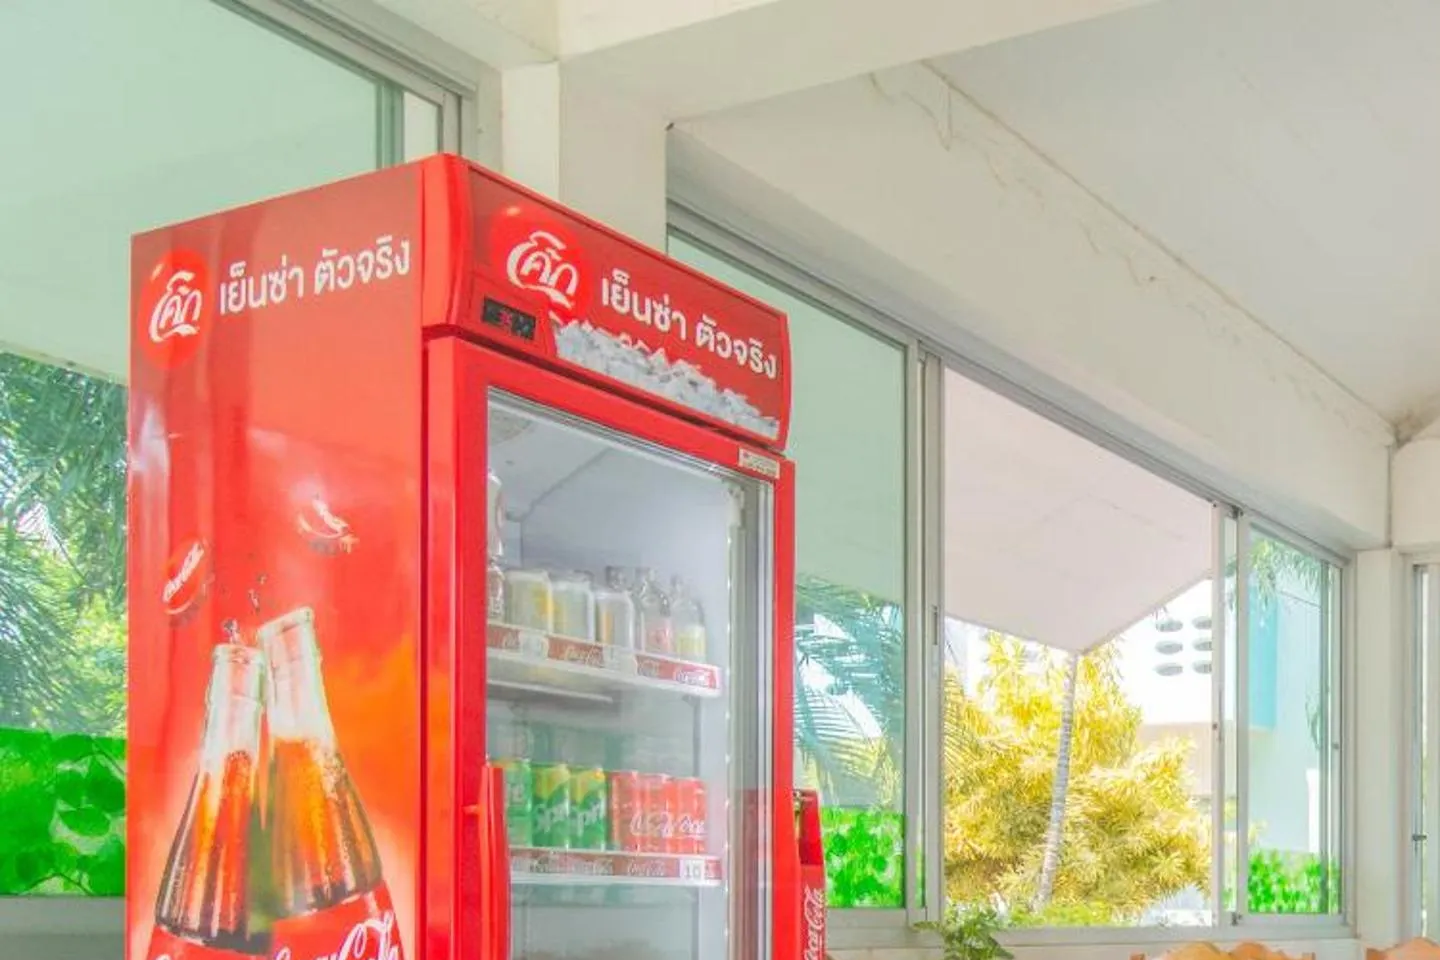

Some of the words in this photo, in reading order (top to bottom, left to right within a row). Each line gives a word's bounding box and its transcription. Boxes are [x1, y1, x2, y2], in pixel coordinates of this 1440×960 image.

[219, 254, 304, 316] เย็นซ่า
[314, 235, 411, 295] ตัวจริง
[602, 267, 687, 341] เย็นซ่า
[696, 313, 777, 379] ตัวจริง
